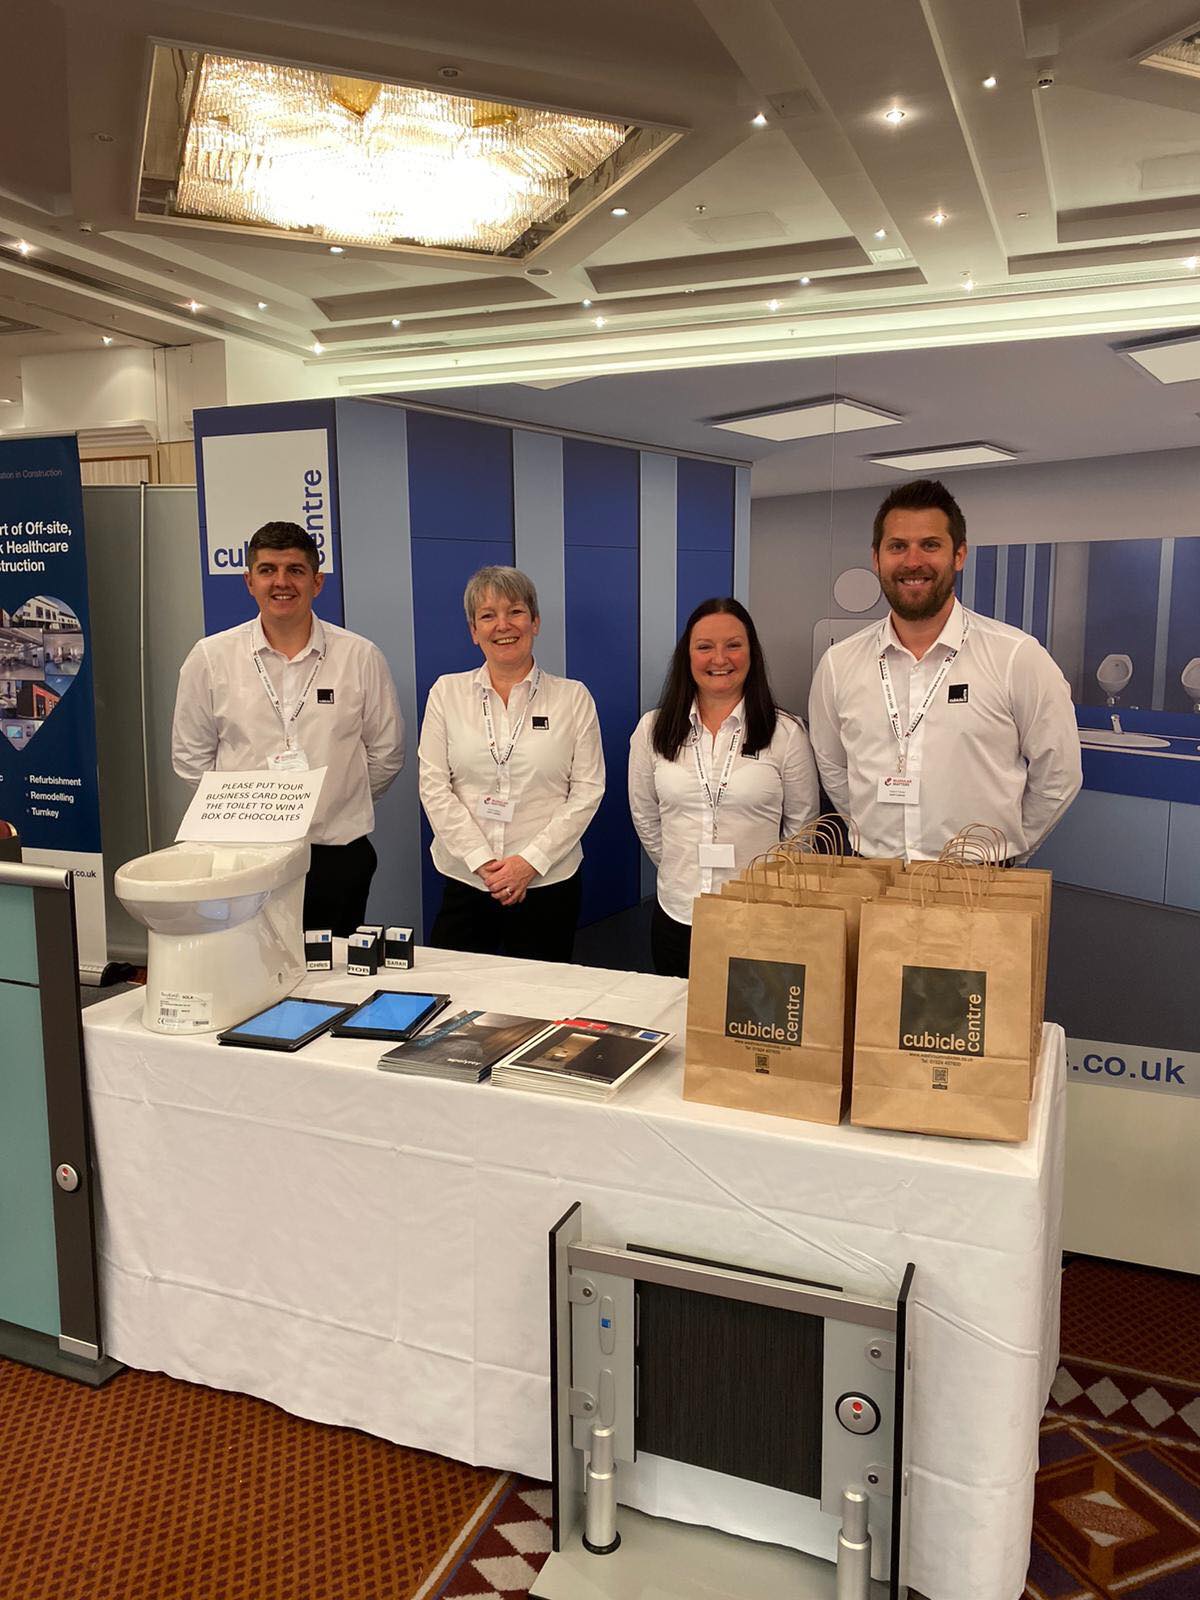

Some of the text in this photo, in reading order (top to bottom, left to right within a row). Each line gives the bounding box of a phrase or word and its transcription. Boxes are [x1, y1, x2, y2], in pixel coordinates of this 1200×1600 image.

[11, 522, 23, 535] of
[25, 521, 72, 536] Off-site,
[6, 540, 69, 554] Healthcare
[29, 774, 82, 786] Refurbishment
[221, 782, 255, 790] PLEASE
[30, 791, 75, 803] Remodelling
[206, 792, 311, 801] BUSINESS CARD DOWN
[31, 807, 60, 818] Turnkey
[226, 802, 257, 810] TOILET
[275, 803, 296, 811] WIN
[200, 812, 301, 821] BOX OF CHOCOLATES
[786, 985, 801, 1042] centre
[966, 993, 982, 1053] centre
[728, 1020, 785, 1040] cubicle
[902, 1031, 966, 1051] cubicle
[1065, 1053, 1186, 1084] .co.uk
